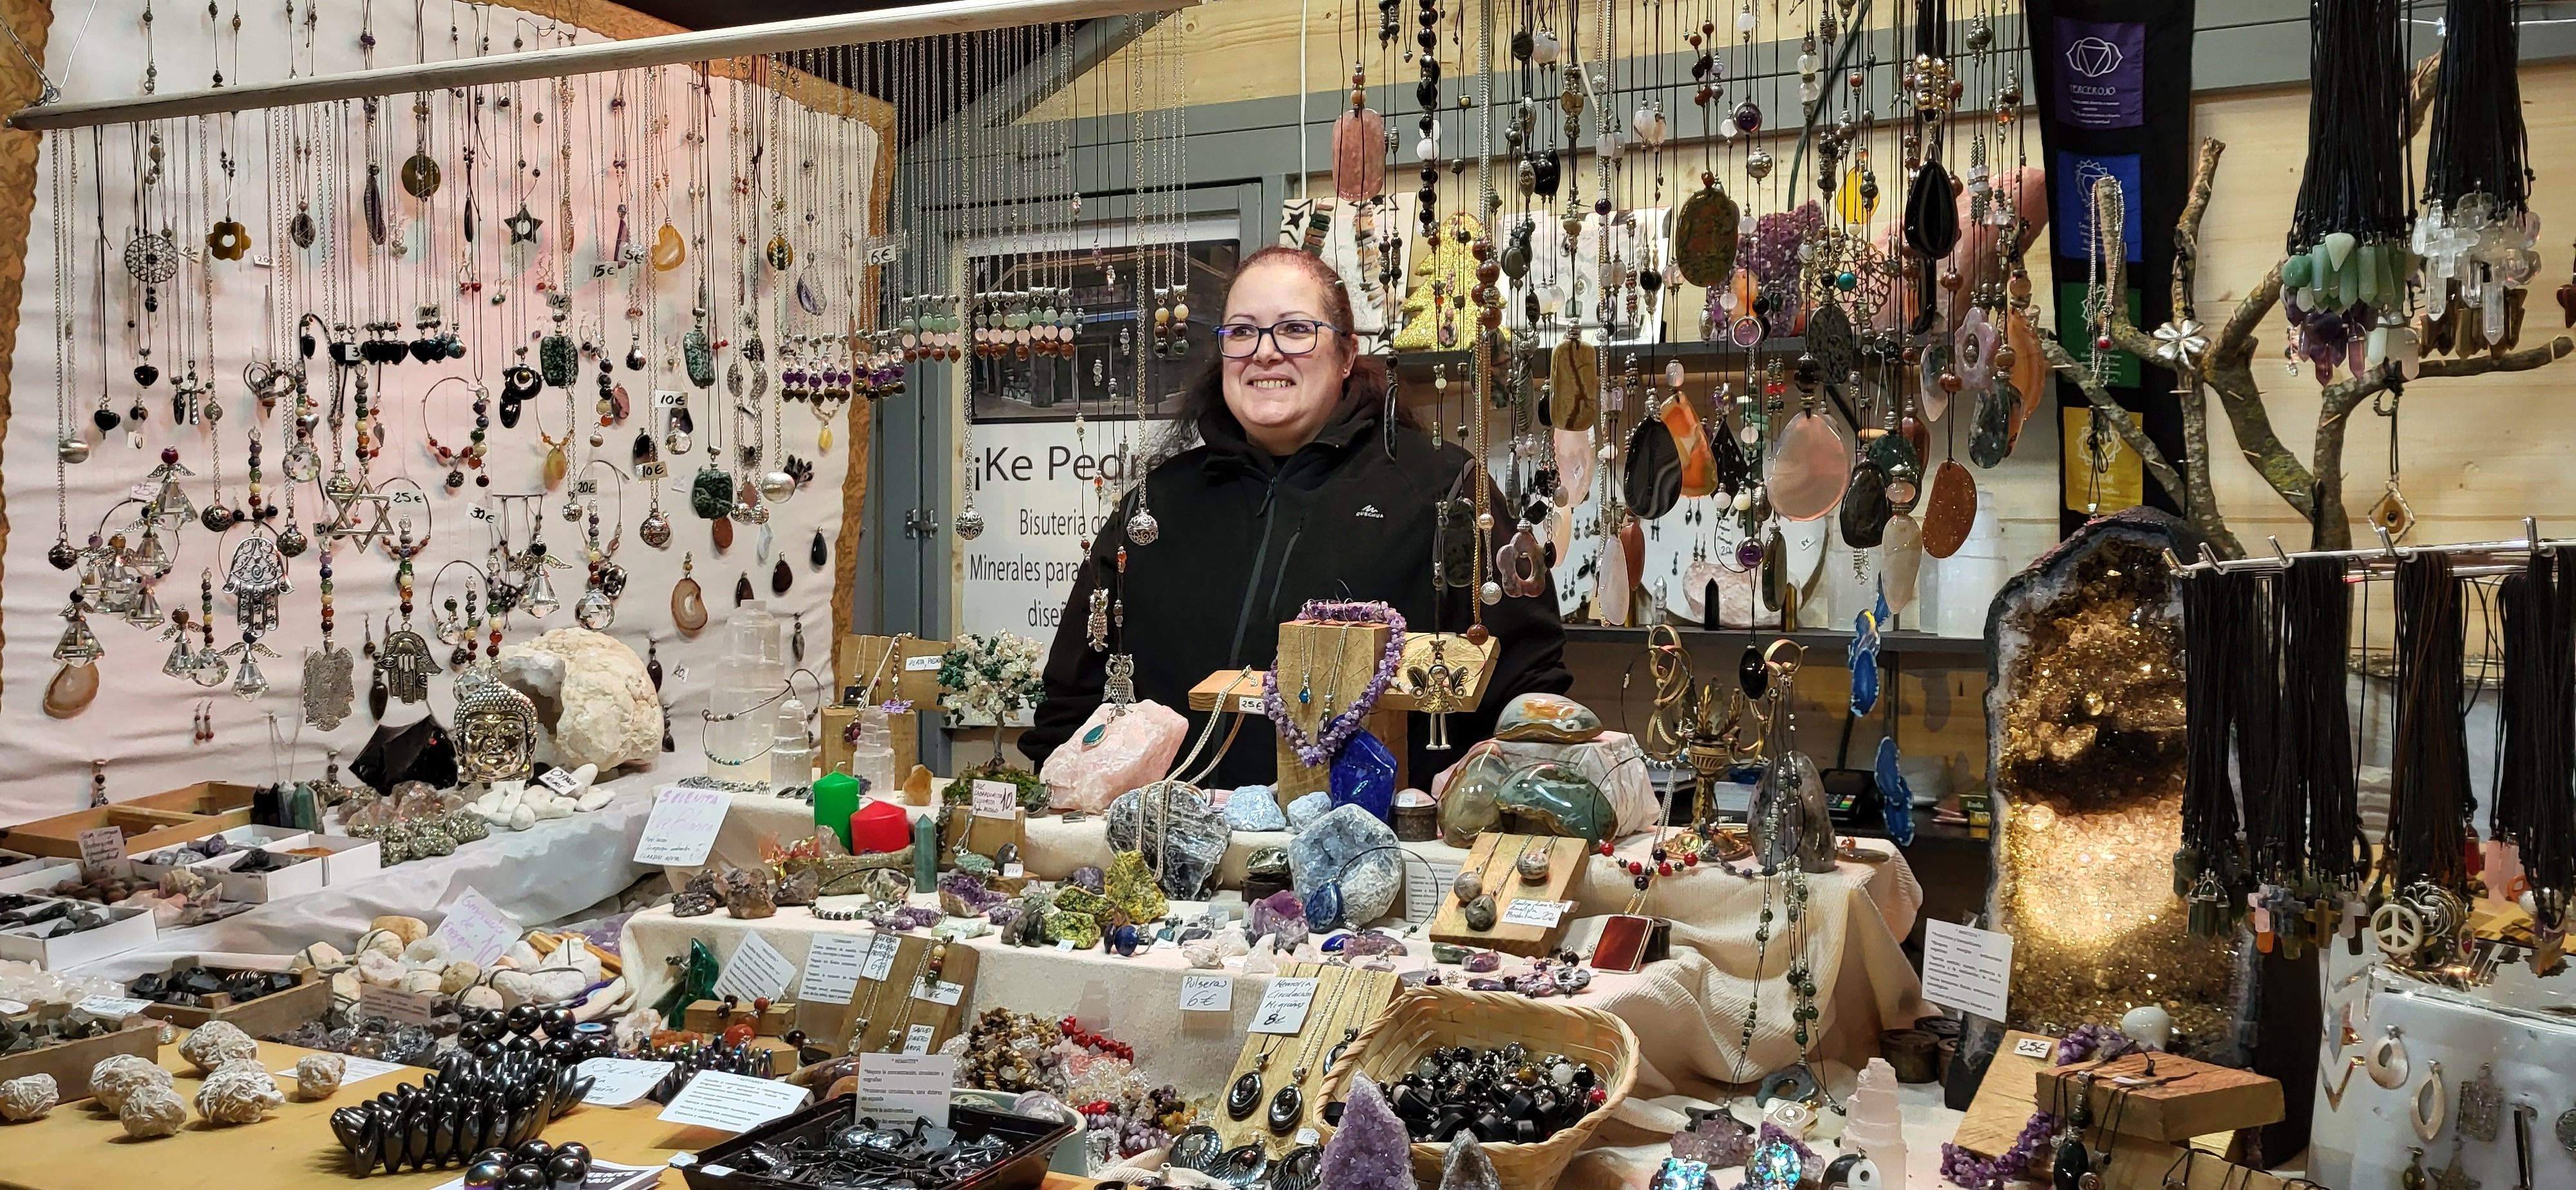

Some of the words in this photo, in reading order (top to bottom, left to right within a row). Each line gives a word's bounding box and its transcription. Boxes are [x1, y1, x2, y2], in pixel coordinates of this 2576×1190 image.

[870, 248, 892, 264] 6€
[593, 265, 614, 278] 15€
[422, 308, 437, 317] 10€
[660, 394, 685, 405] 10€
[643, 464, 664, 478] 10€
[974, 446, 1033, 491] ¡Ke
[394, 491, 422, 503] 25€
[469, 507, 495, 523] 30€
[970, 553, 1041, 582] Minerales
[1046, 563, 1079, 589] para
[1241, 699, 1262, 711] 25€
[1184, 976, 1227, 989] Pulseras
[1186, 990, 1217, 1007] 6€
[2019, 1041, 2047, 1053] 25€
